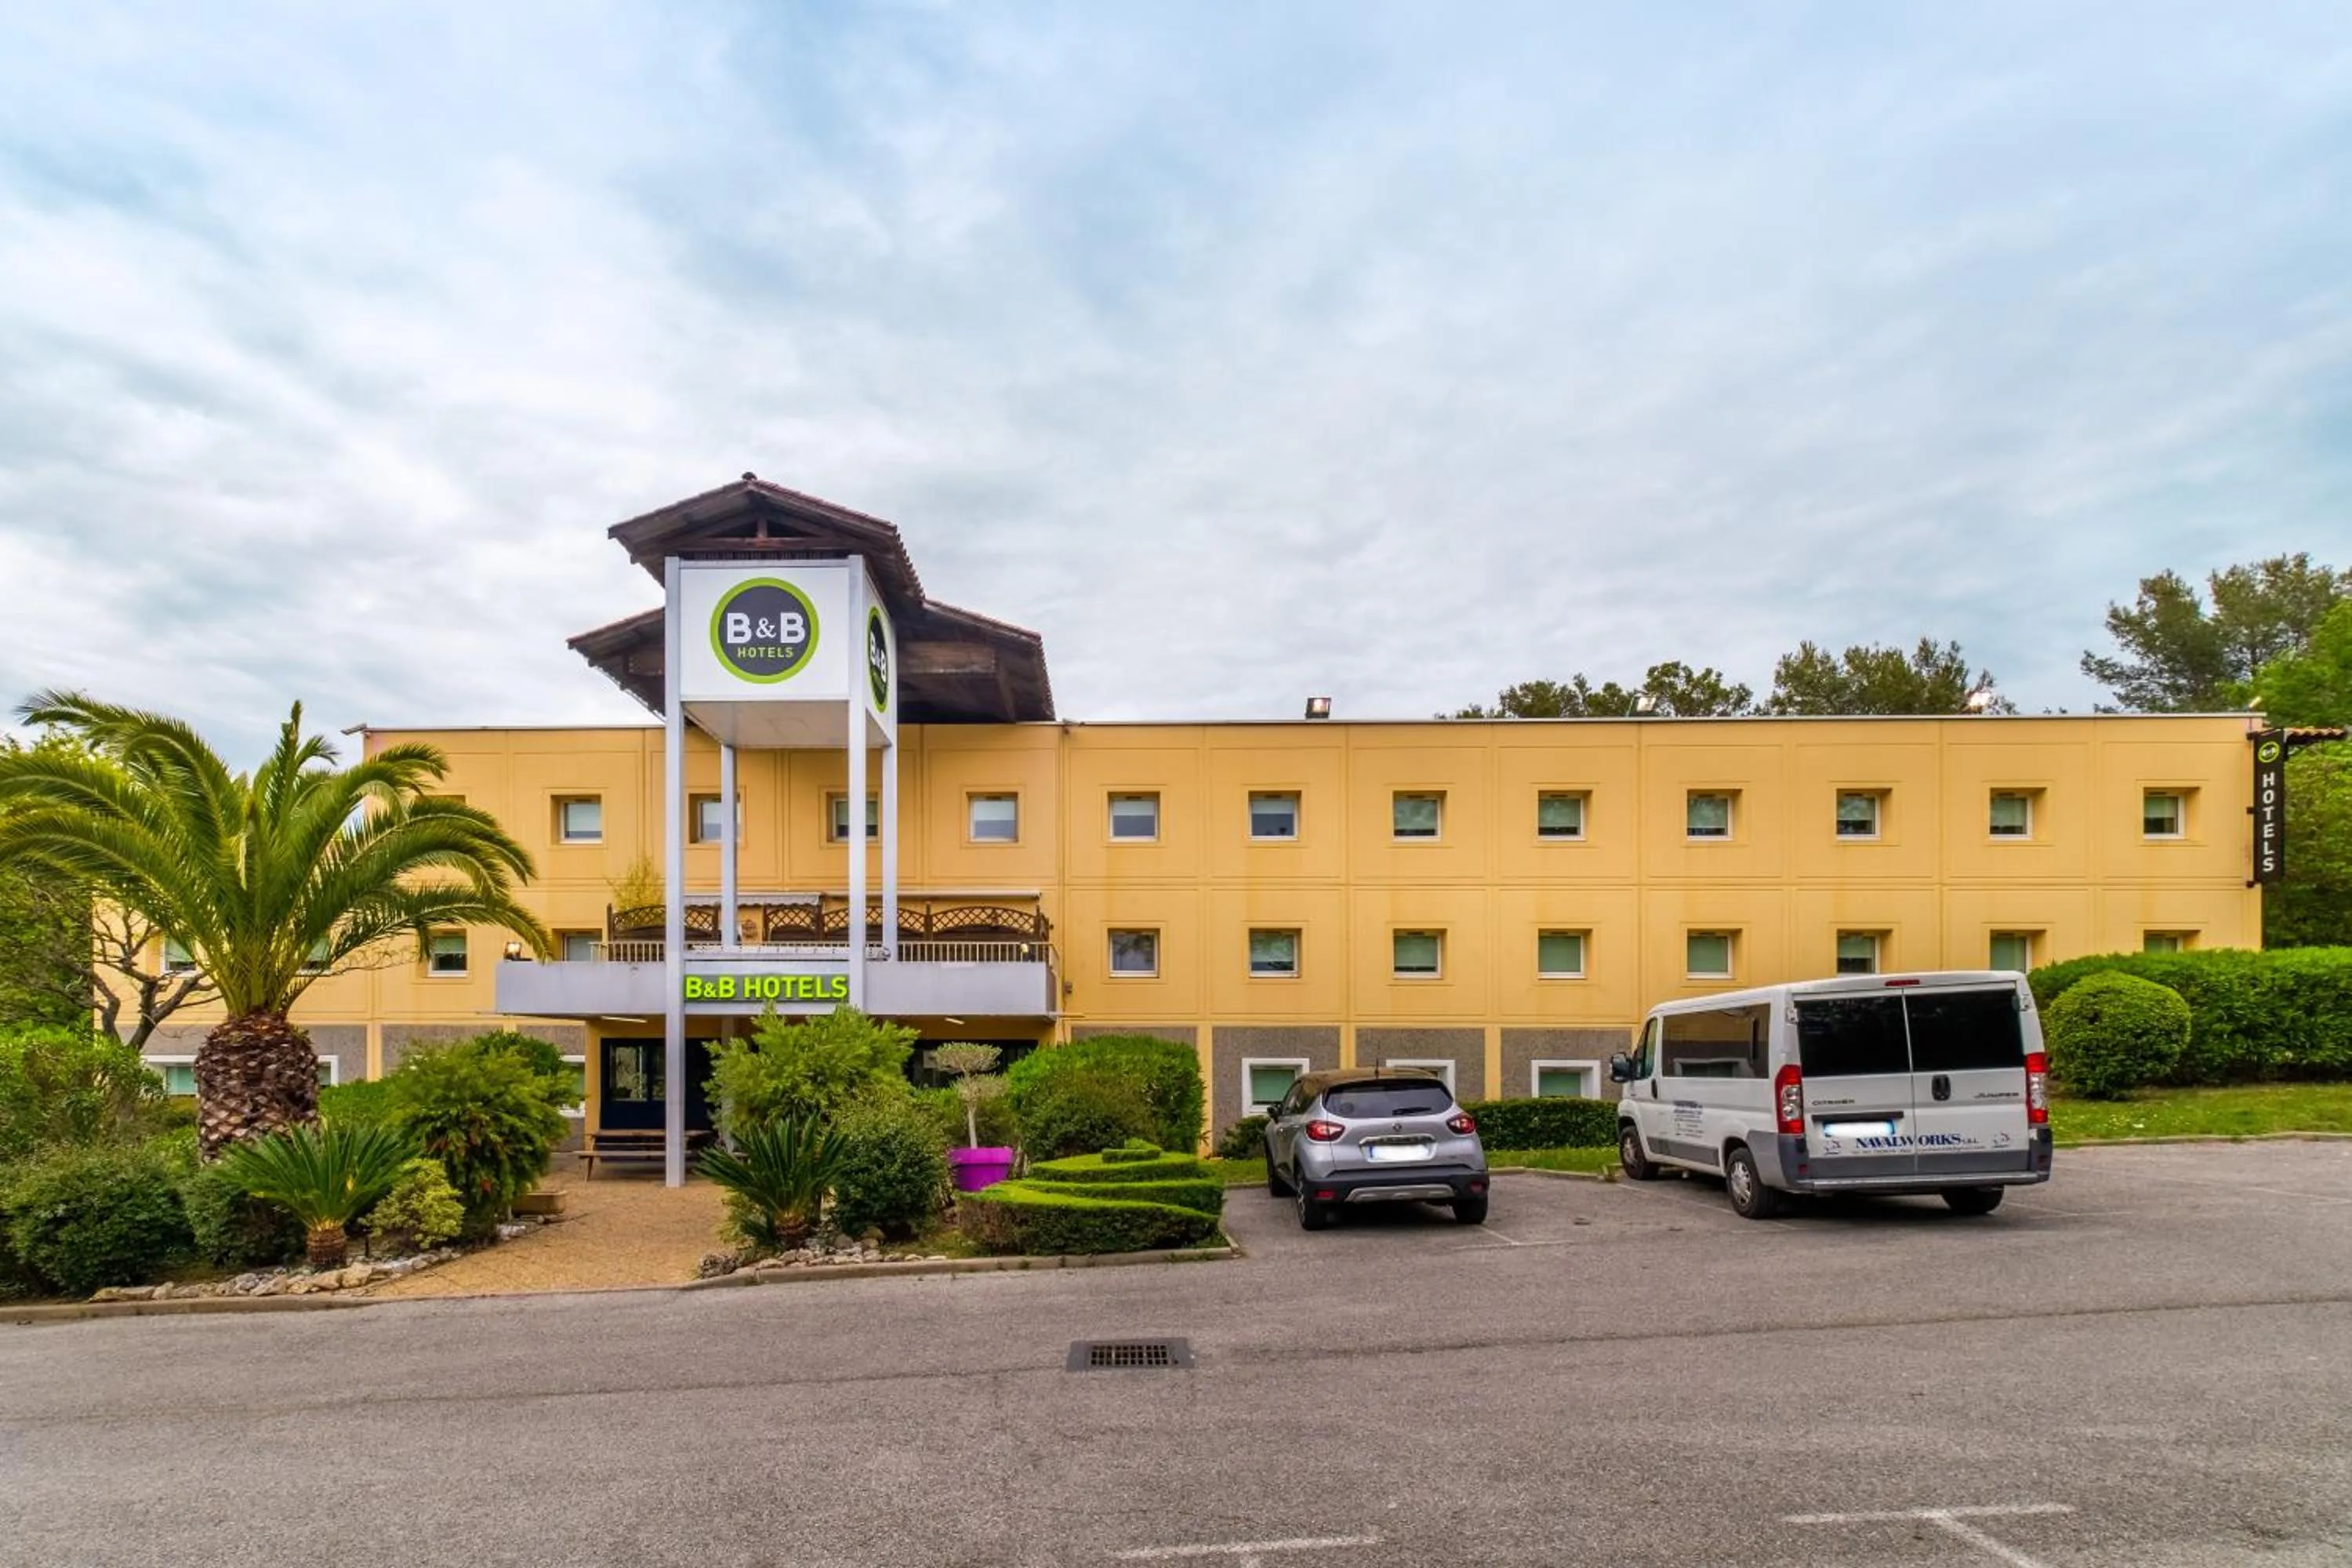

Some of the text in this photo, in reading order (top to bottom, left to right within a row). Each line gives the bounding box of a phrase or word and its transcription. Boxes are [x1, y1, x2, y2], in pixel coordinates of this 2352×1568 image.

[727, 612, 806, 644] B&B
[736, 646, 794, 659] HOTELS
[2262, 771, 2275, 873] HOTELS
[685, 976, 848, 999] B&B HOTELS
